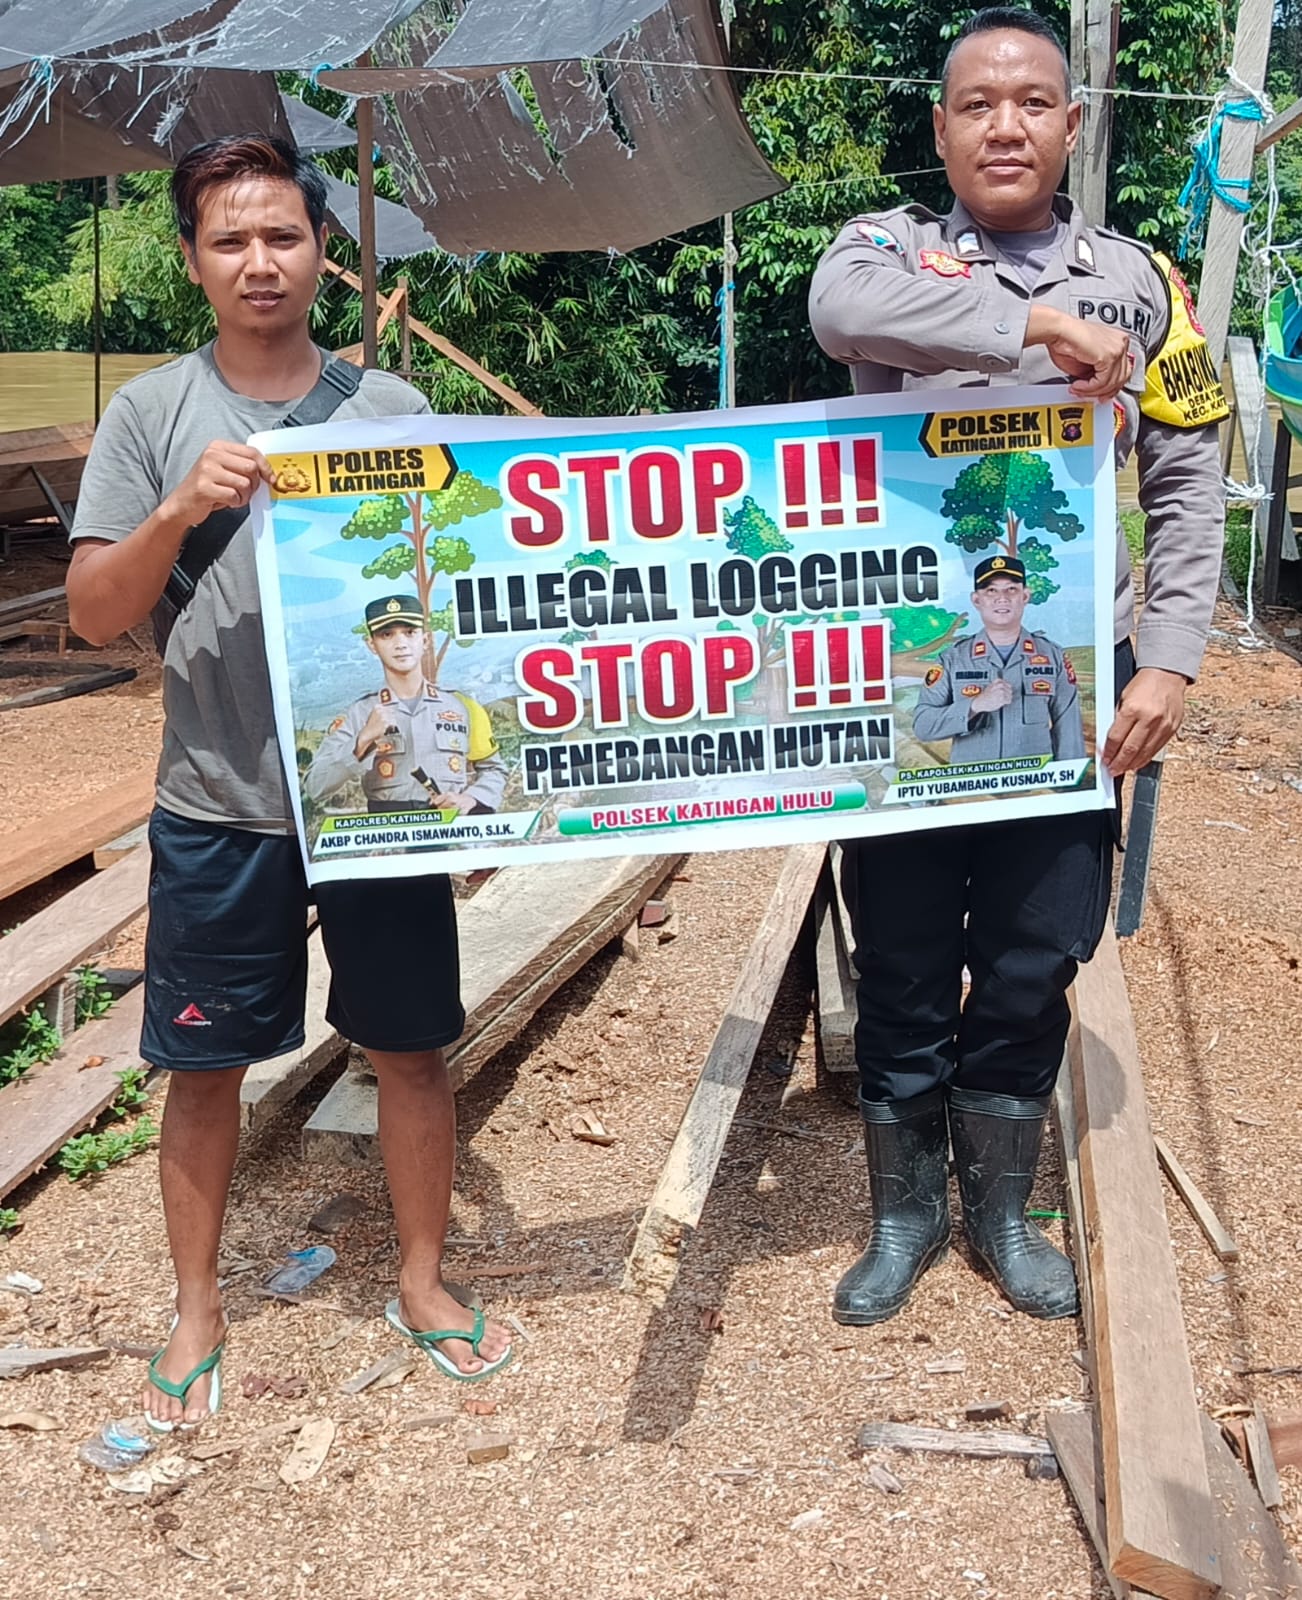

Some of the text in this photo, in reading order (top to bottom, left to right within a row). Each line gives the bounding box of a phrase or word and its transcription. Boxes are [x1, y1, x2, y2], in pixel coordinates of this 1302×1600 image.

[1078, 299, 1152, 339] POLRI
[940, 411, 1041, 438] POLSEK
[1183, 405, 1210, 421] KEC.
[941, 433, 1042, 454] KATINGAN HULU
[326, 447, 424, 475] POLRES
[328, 471, 426, 493] KATINGAN
[507, 438, 880, 547] STOP !!!
[455, 545, 939, 635] ILLEGAL LOGGING
[521, 624, 886, 730] STOP !!!
[1025, 666, 1054, 676] POLRI
[435, 723, 467, 735] POLRI
[524, 718, 891, 791] PENEBANGAN HUTAN
[917, 766, 965, 778] KAPOLSEK
[967, 761, 1013, 773] KATINGAN
[1015, 758, 1040, 768] HULU
[897, 769, 1074, 798] IPTU YUBAMBANG KUSNADY, SH
[335, 812, 441, 829] KAPOLRES KATINGAN
[592, 790, 833, 828] POLSEK KATINGAN HULU
[320, 824, 514, 849] AKBP CHANDRA ISMAWANTO, S.I.K.
